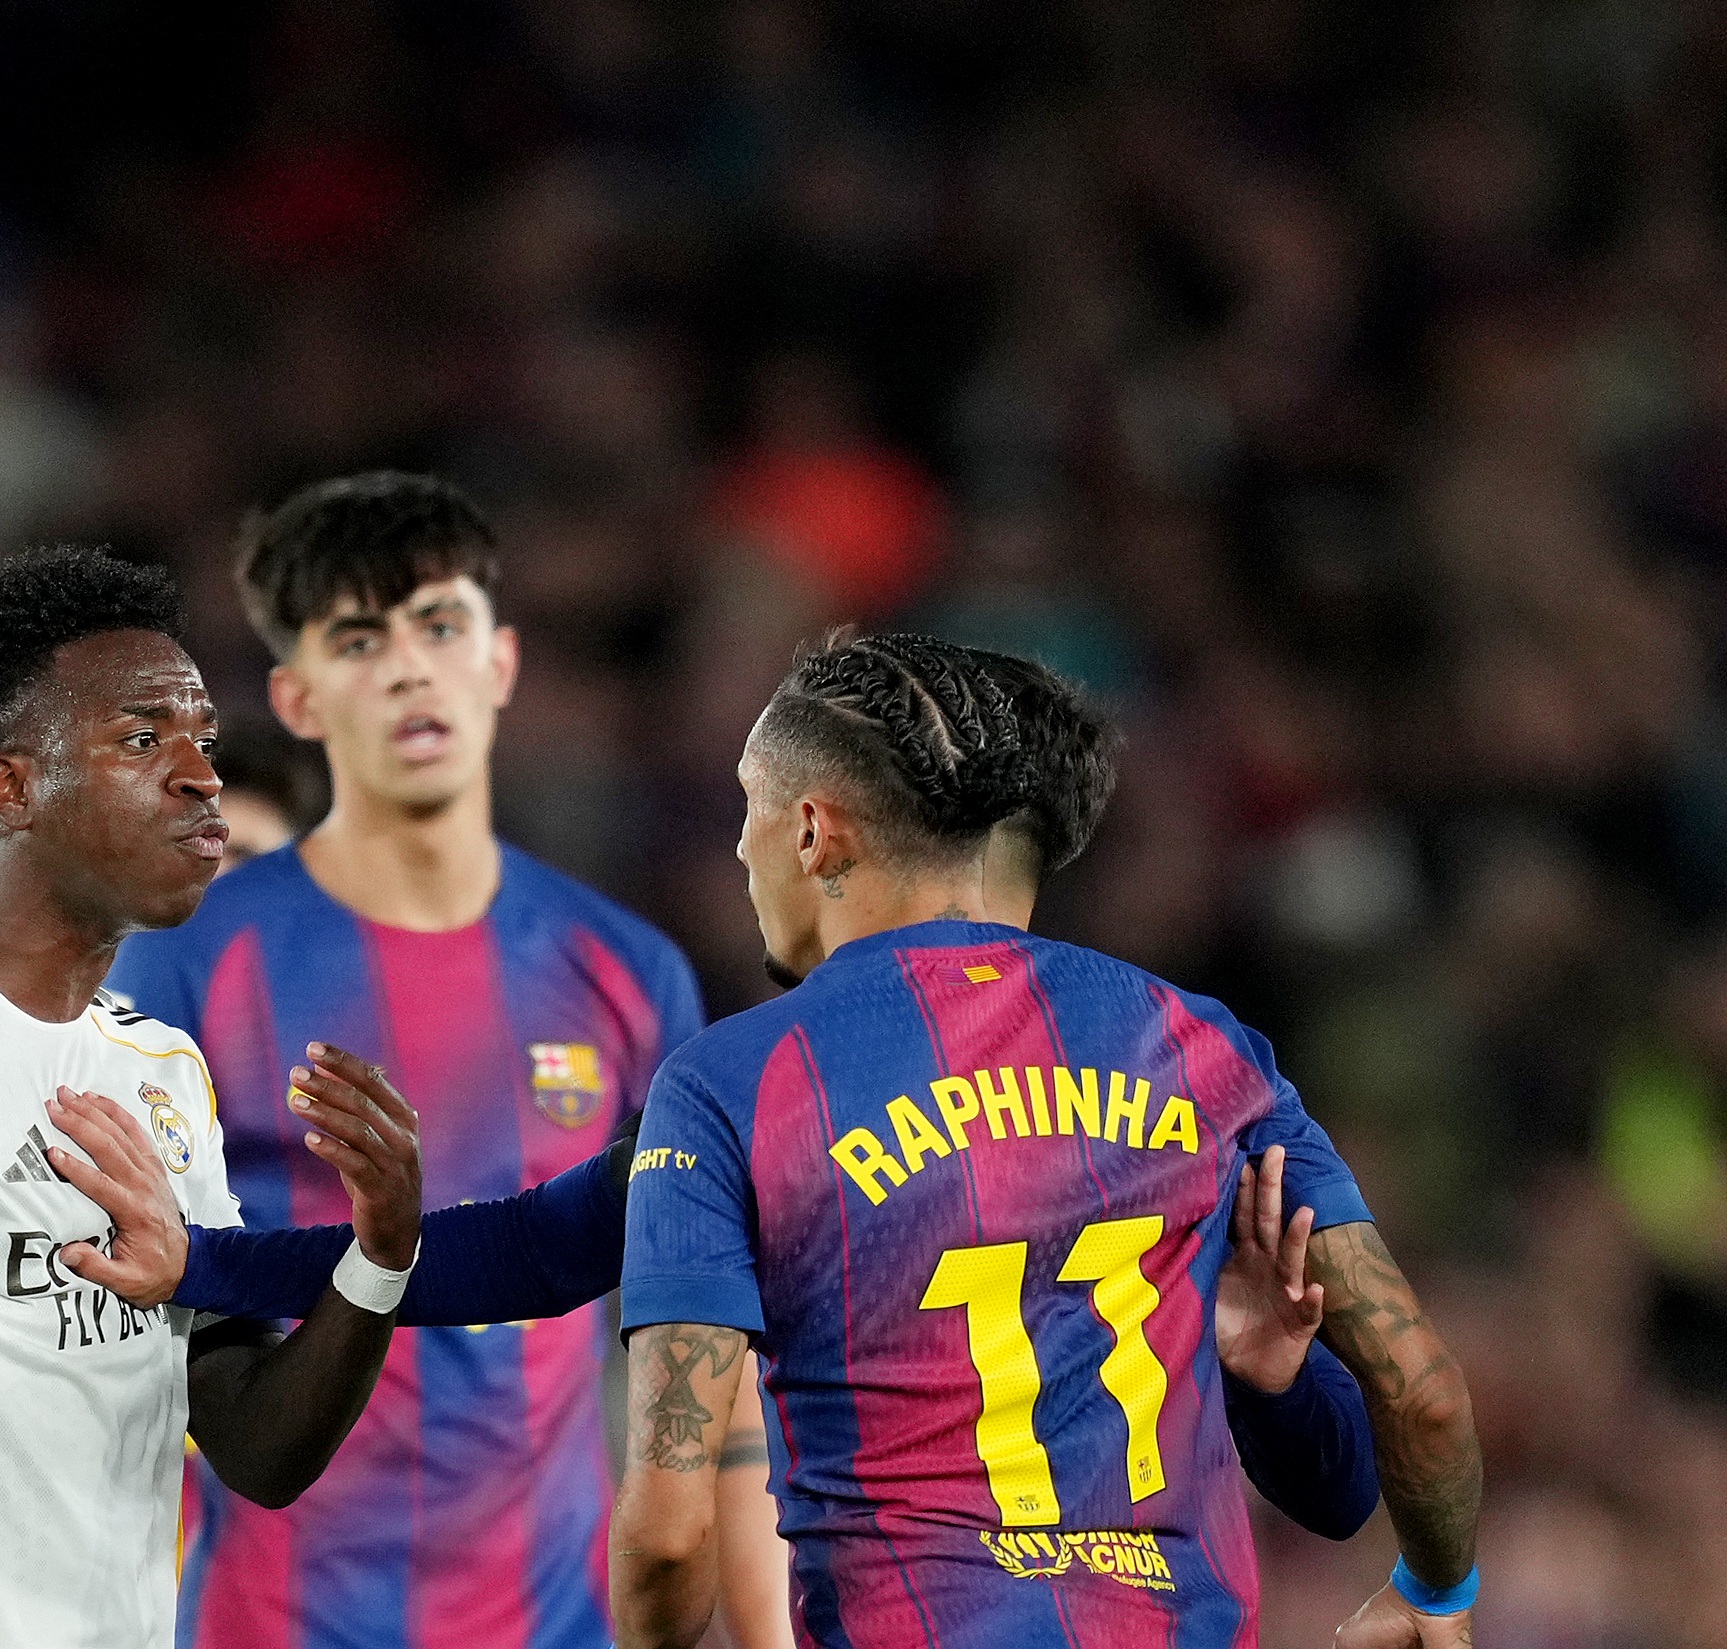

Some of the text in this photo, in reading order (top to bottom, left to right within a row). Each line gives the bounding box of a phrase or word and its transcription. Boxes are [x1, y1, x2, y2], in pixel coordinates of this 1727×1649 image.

[675, 1149, 697, 1170] tv
[828, 1066, 1200, 1206] RAPHINHA
[918, 1214, 1168, 1527] 11
